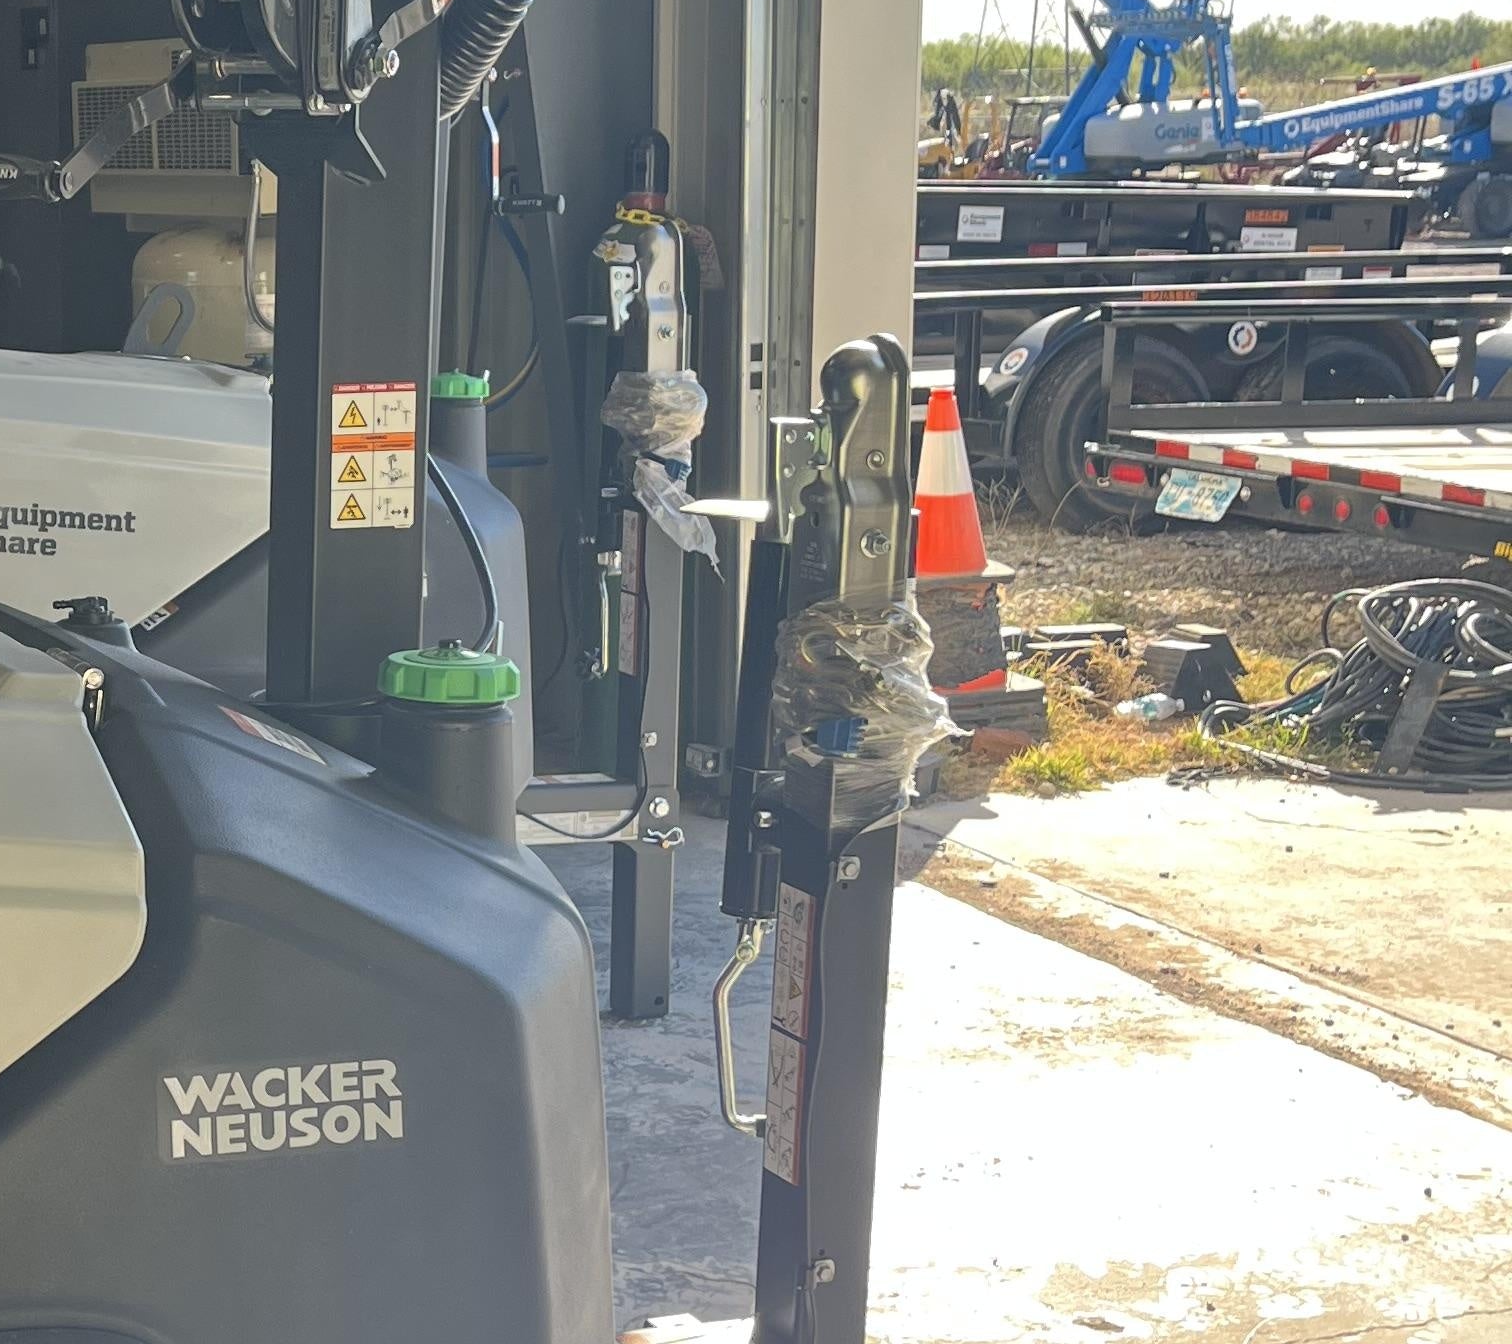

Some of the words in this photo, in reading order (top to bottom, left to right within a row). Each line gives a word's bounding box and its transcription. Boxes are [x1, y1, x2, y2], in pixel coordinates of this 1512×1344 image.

[1301, 97, 1425, 133] EquipmentShare
[1437, 77, 1495, 111] S-65
[163, 1059, 402, 1115] WACKER
[170, 1099, 404, 1158] NEUSON
